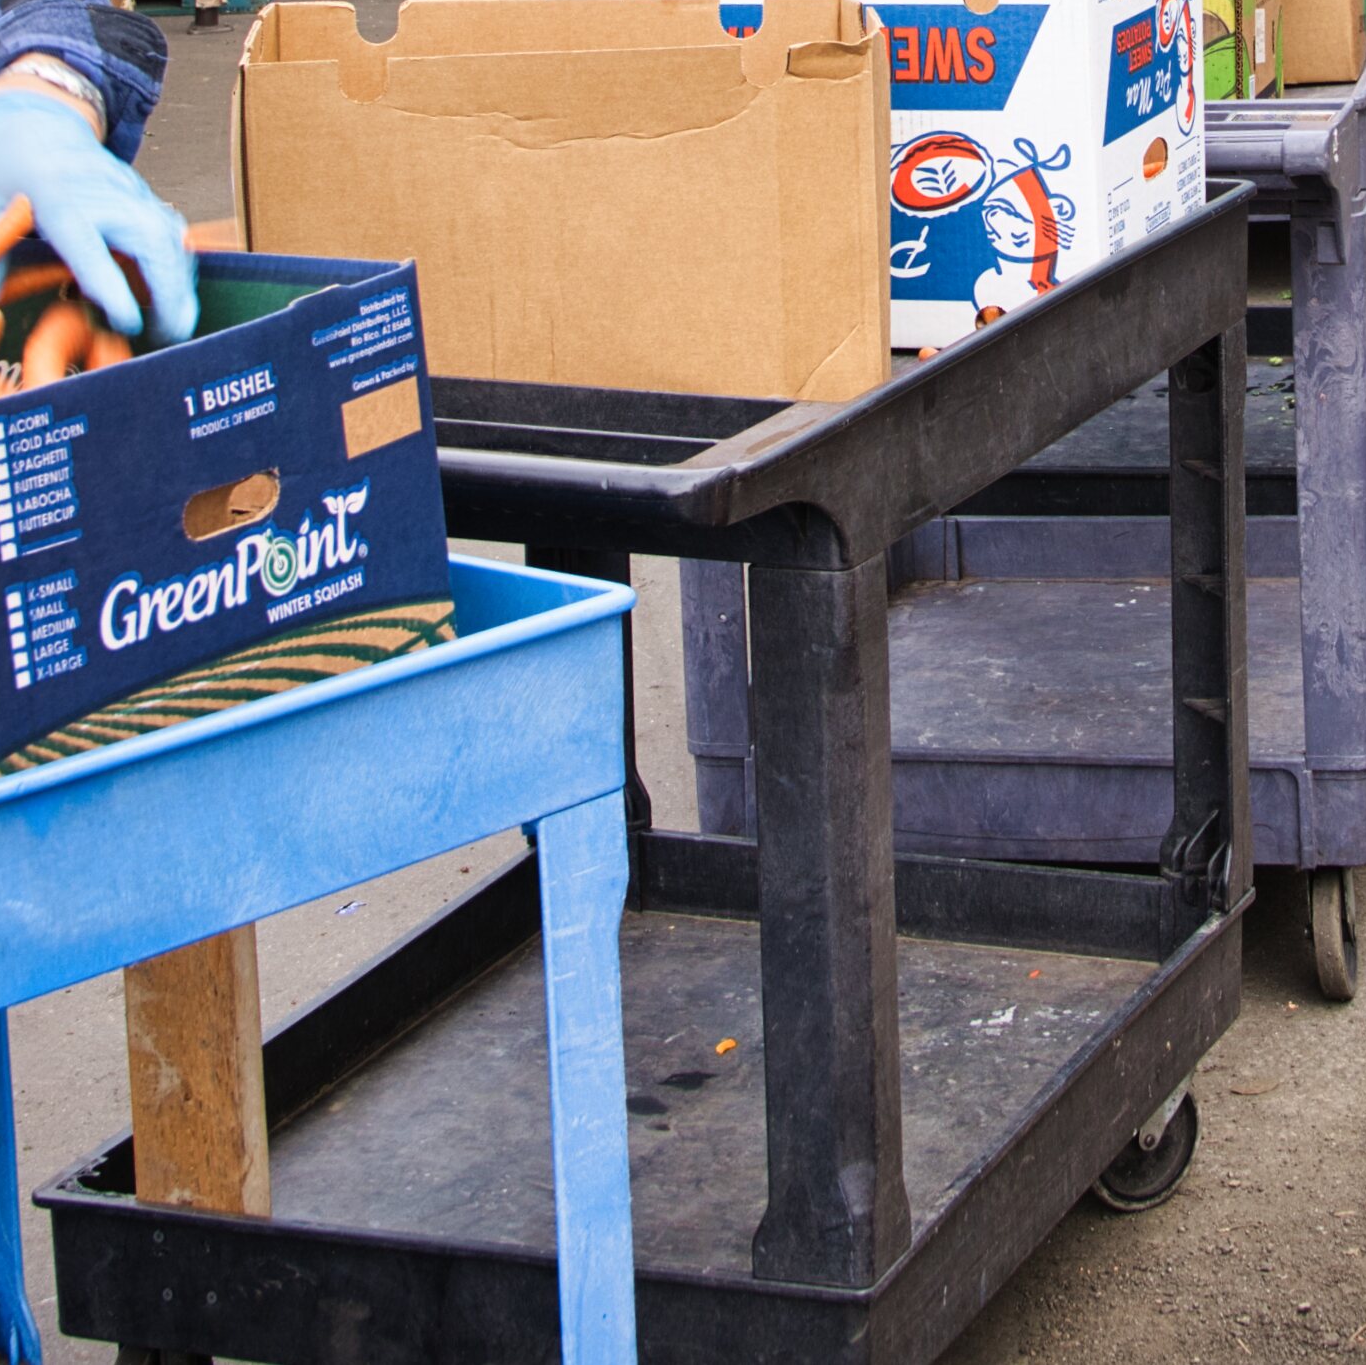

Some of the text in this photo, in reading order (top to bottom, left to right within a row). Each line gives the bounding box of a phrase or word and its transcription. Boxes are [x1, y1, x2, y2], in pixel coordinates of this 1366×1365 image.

[1116, 18, 1153, 55] POTATOES
[889, 25, 998, 83] SWE
[1128, 41, 1154, 74] SWEET
[1125, 59, 1172, 117] Pie Man
[184, 369, 276, 417] 1 BUSHEL
[8, 412, 50, 435] ACORN
[190, 400, 276, 440] PRODUCE OF MEXICO
[10, 422, 85, 455] GOLD ACORN
[11, 447, 69, 476] SPAGHETTI
[14, 466, 71, 495] BUTTERNUT
[99, 476, 369, 651] GreenPoint
[29, 600, 64, 622] SMALL
[267, 571, 364, 624] WINTER SQUASH
[31, 616, 77, 643] MEDIUM
[33, 638, 70, 662] LARGE
[36, 653, 84, 682] X-LARGE
